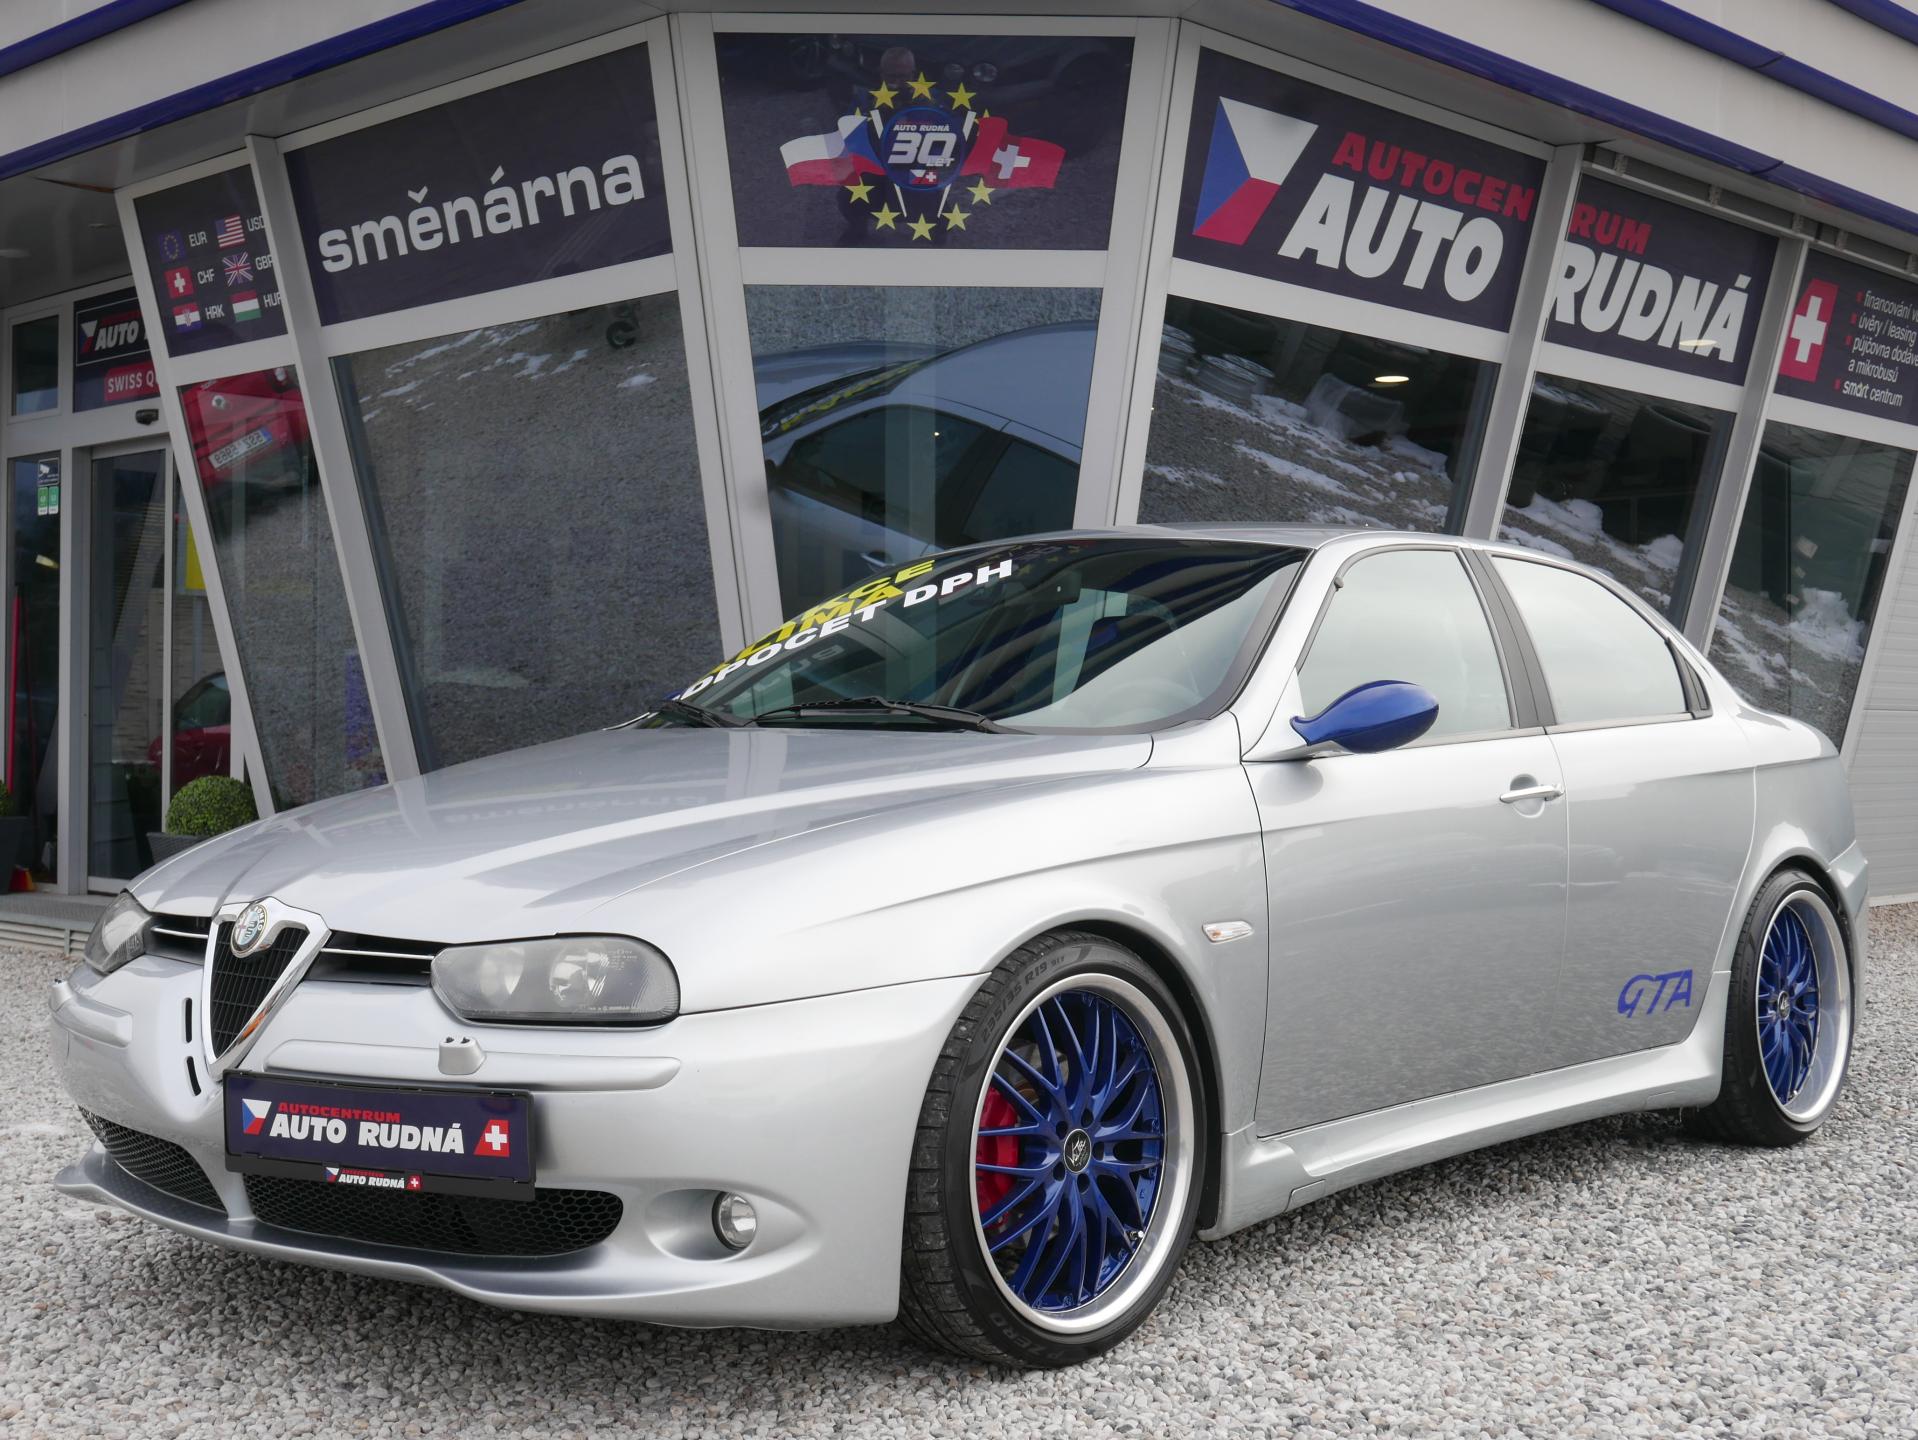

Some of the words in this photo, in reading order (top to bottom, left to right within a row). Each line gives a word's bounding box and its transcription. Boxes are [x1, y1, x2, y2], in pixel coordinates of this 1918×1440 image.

[893, 124, 917, 132] AUTO
[887, 131, 957, 164] 30
[926, 157, 955, 167] LET
[318, 154, 646, 273] směnárna
[189, 231, 208, 247] EUR
[197, 268, 215, 285] CHF
[1277, 173, 1503, 301] AUTO
[1550, 241, 1751, 363] RUDNÁ
[205, 304, 225, 320] HRK
[1863, 290, 1912, 320] financování
[94, 320, 139, 351] AUTO
[1858, 312, 1884, 337] úvěry
[1888, 322, 1917, 347] leasing
[1848, 358, 1856, 373] a
[107, 372, 142, 393] SWISS
[1869, 387, 1904, 407] centrum
[904, 559, 1013, 608] DPH
[1025, 961, 1048, 985] R19
[1617, 969, 1693, 1018] GTA
[277, 1102, 400, 1123] AUTOCENTRUM
[269, 1113, 347, 1144] AUTO
[358, 1121, 465, 1155] RUDNÁ
[338, 1173, 367, 1186] AUTO
[368, 1176, 405, 1189] RUDNÁ
